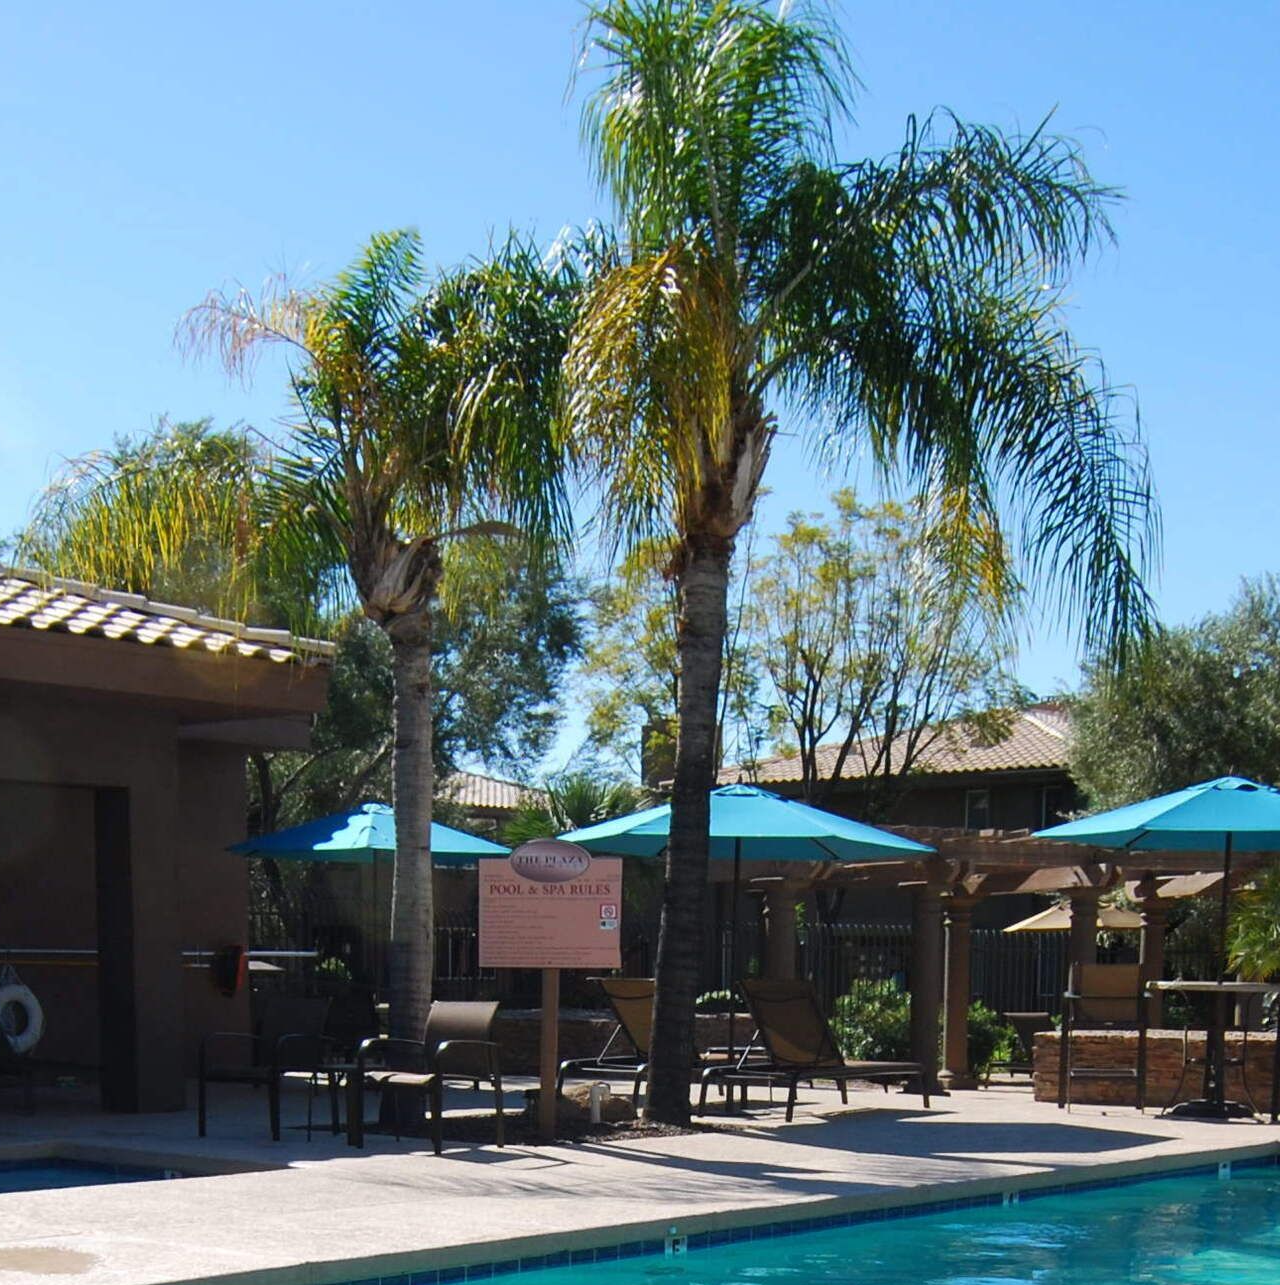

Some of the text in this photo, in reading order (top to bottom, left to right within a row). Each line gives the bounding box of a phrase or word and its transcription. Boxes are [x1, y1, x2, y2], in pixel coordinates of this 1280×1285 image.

[518, 856, 584, 864] THE PLAZA
[489, 884, 611, 895] POOL & SPA RULES
